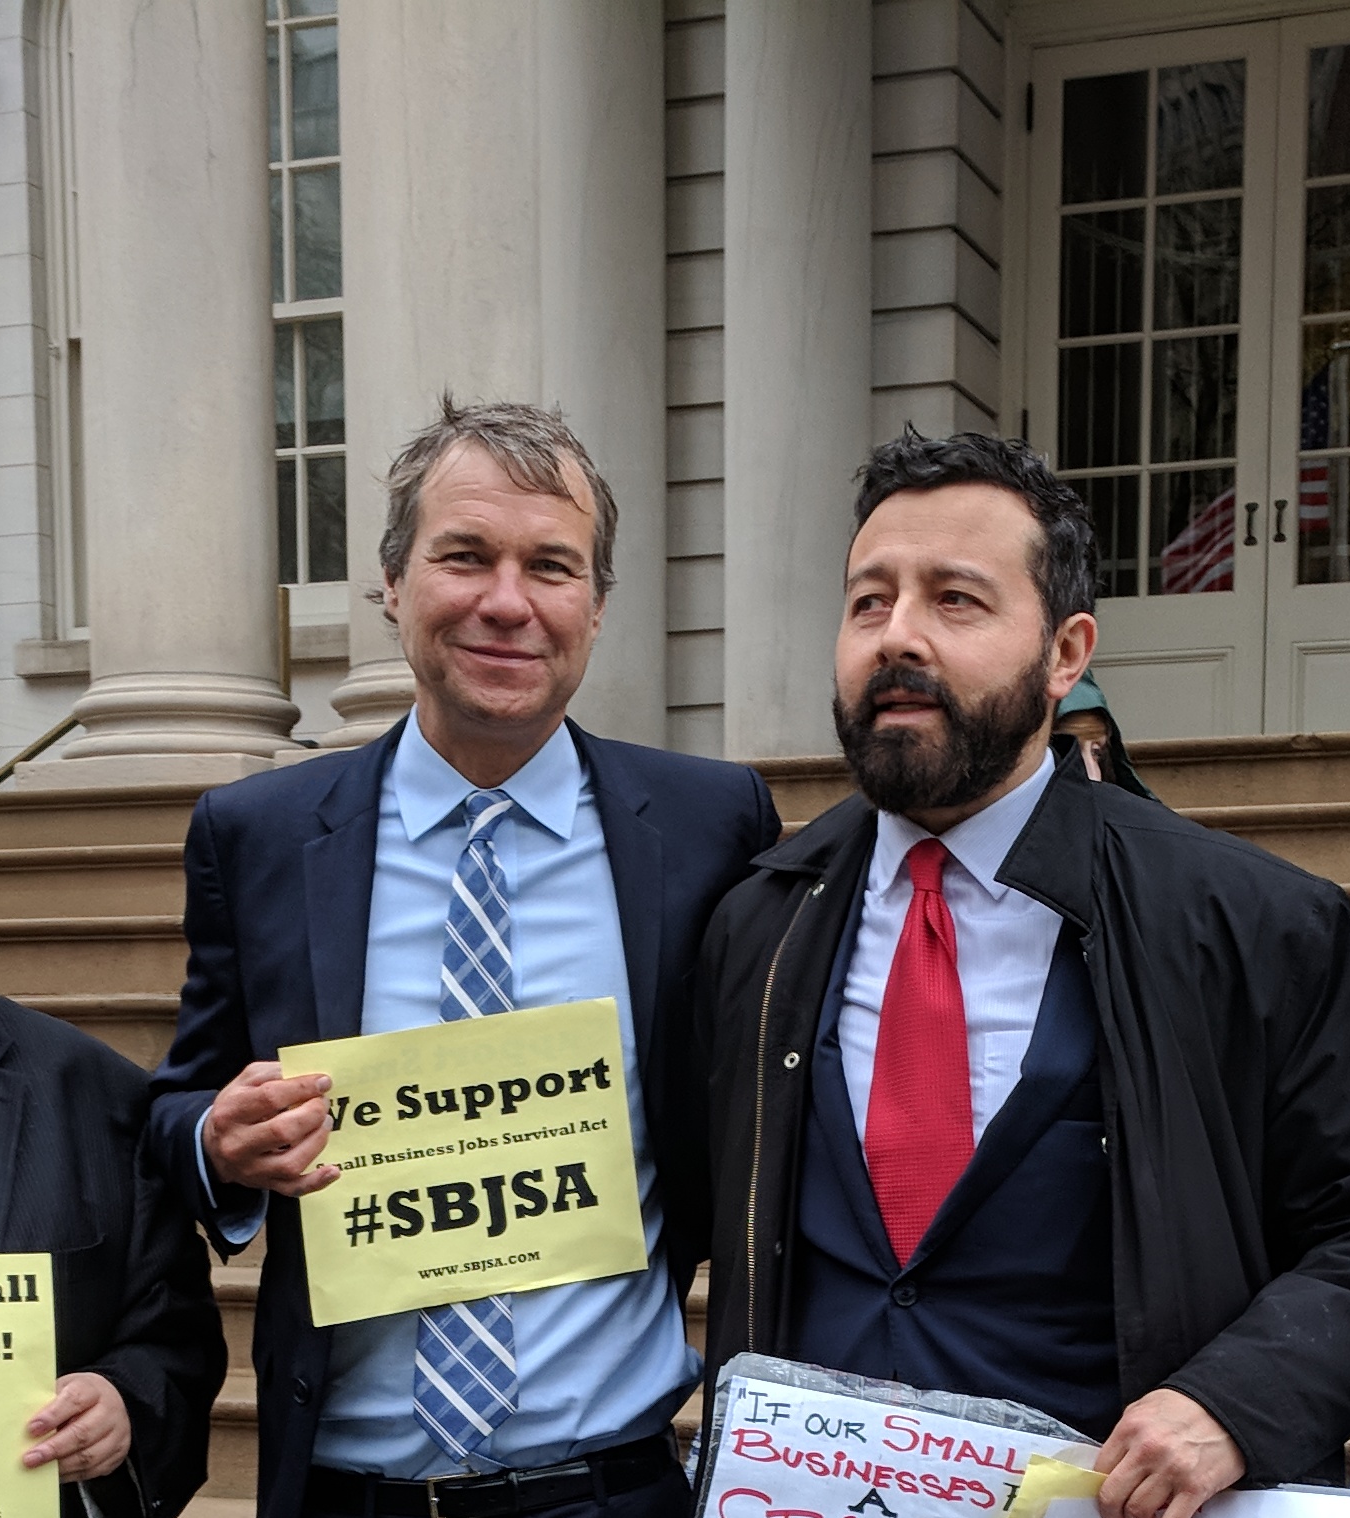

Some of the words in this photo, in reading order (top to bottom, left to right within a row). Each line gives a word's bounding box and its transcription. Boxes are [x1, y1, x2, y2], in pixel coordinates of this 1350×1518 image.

[396, 1057, 611, 1121] Support
[316, 1155, 368, 1172] all
[371, 1141, 455, 1166] Business
[458, 1134, 499, 1155] Jobs
[502, 1122, 576, 1146] Survival
[579, 1117, 608, 1134] Act
[344, 1161, 599, 1247] #SBJSA
[418, 1250, 541, 1279] WWW.SBJSA.COM
[805, 1413, 867, 1443] OUR
[882, 1414, 1026, 1476] SMALL
[847, 1488, 898, 1518] A
